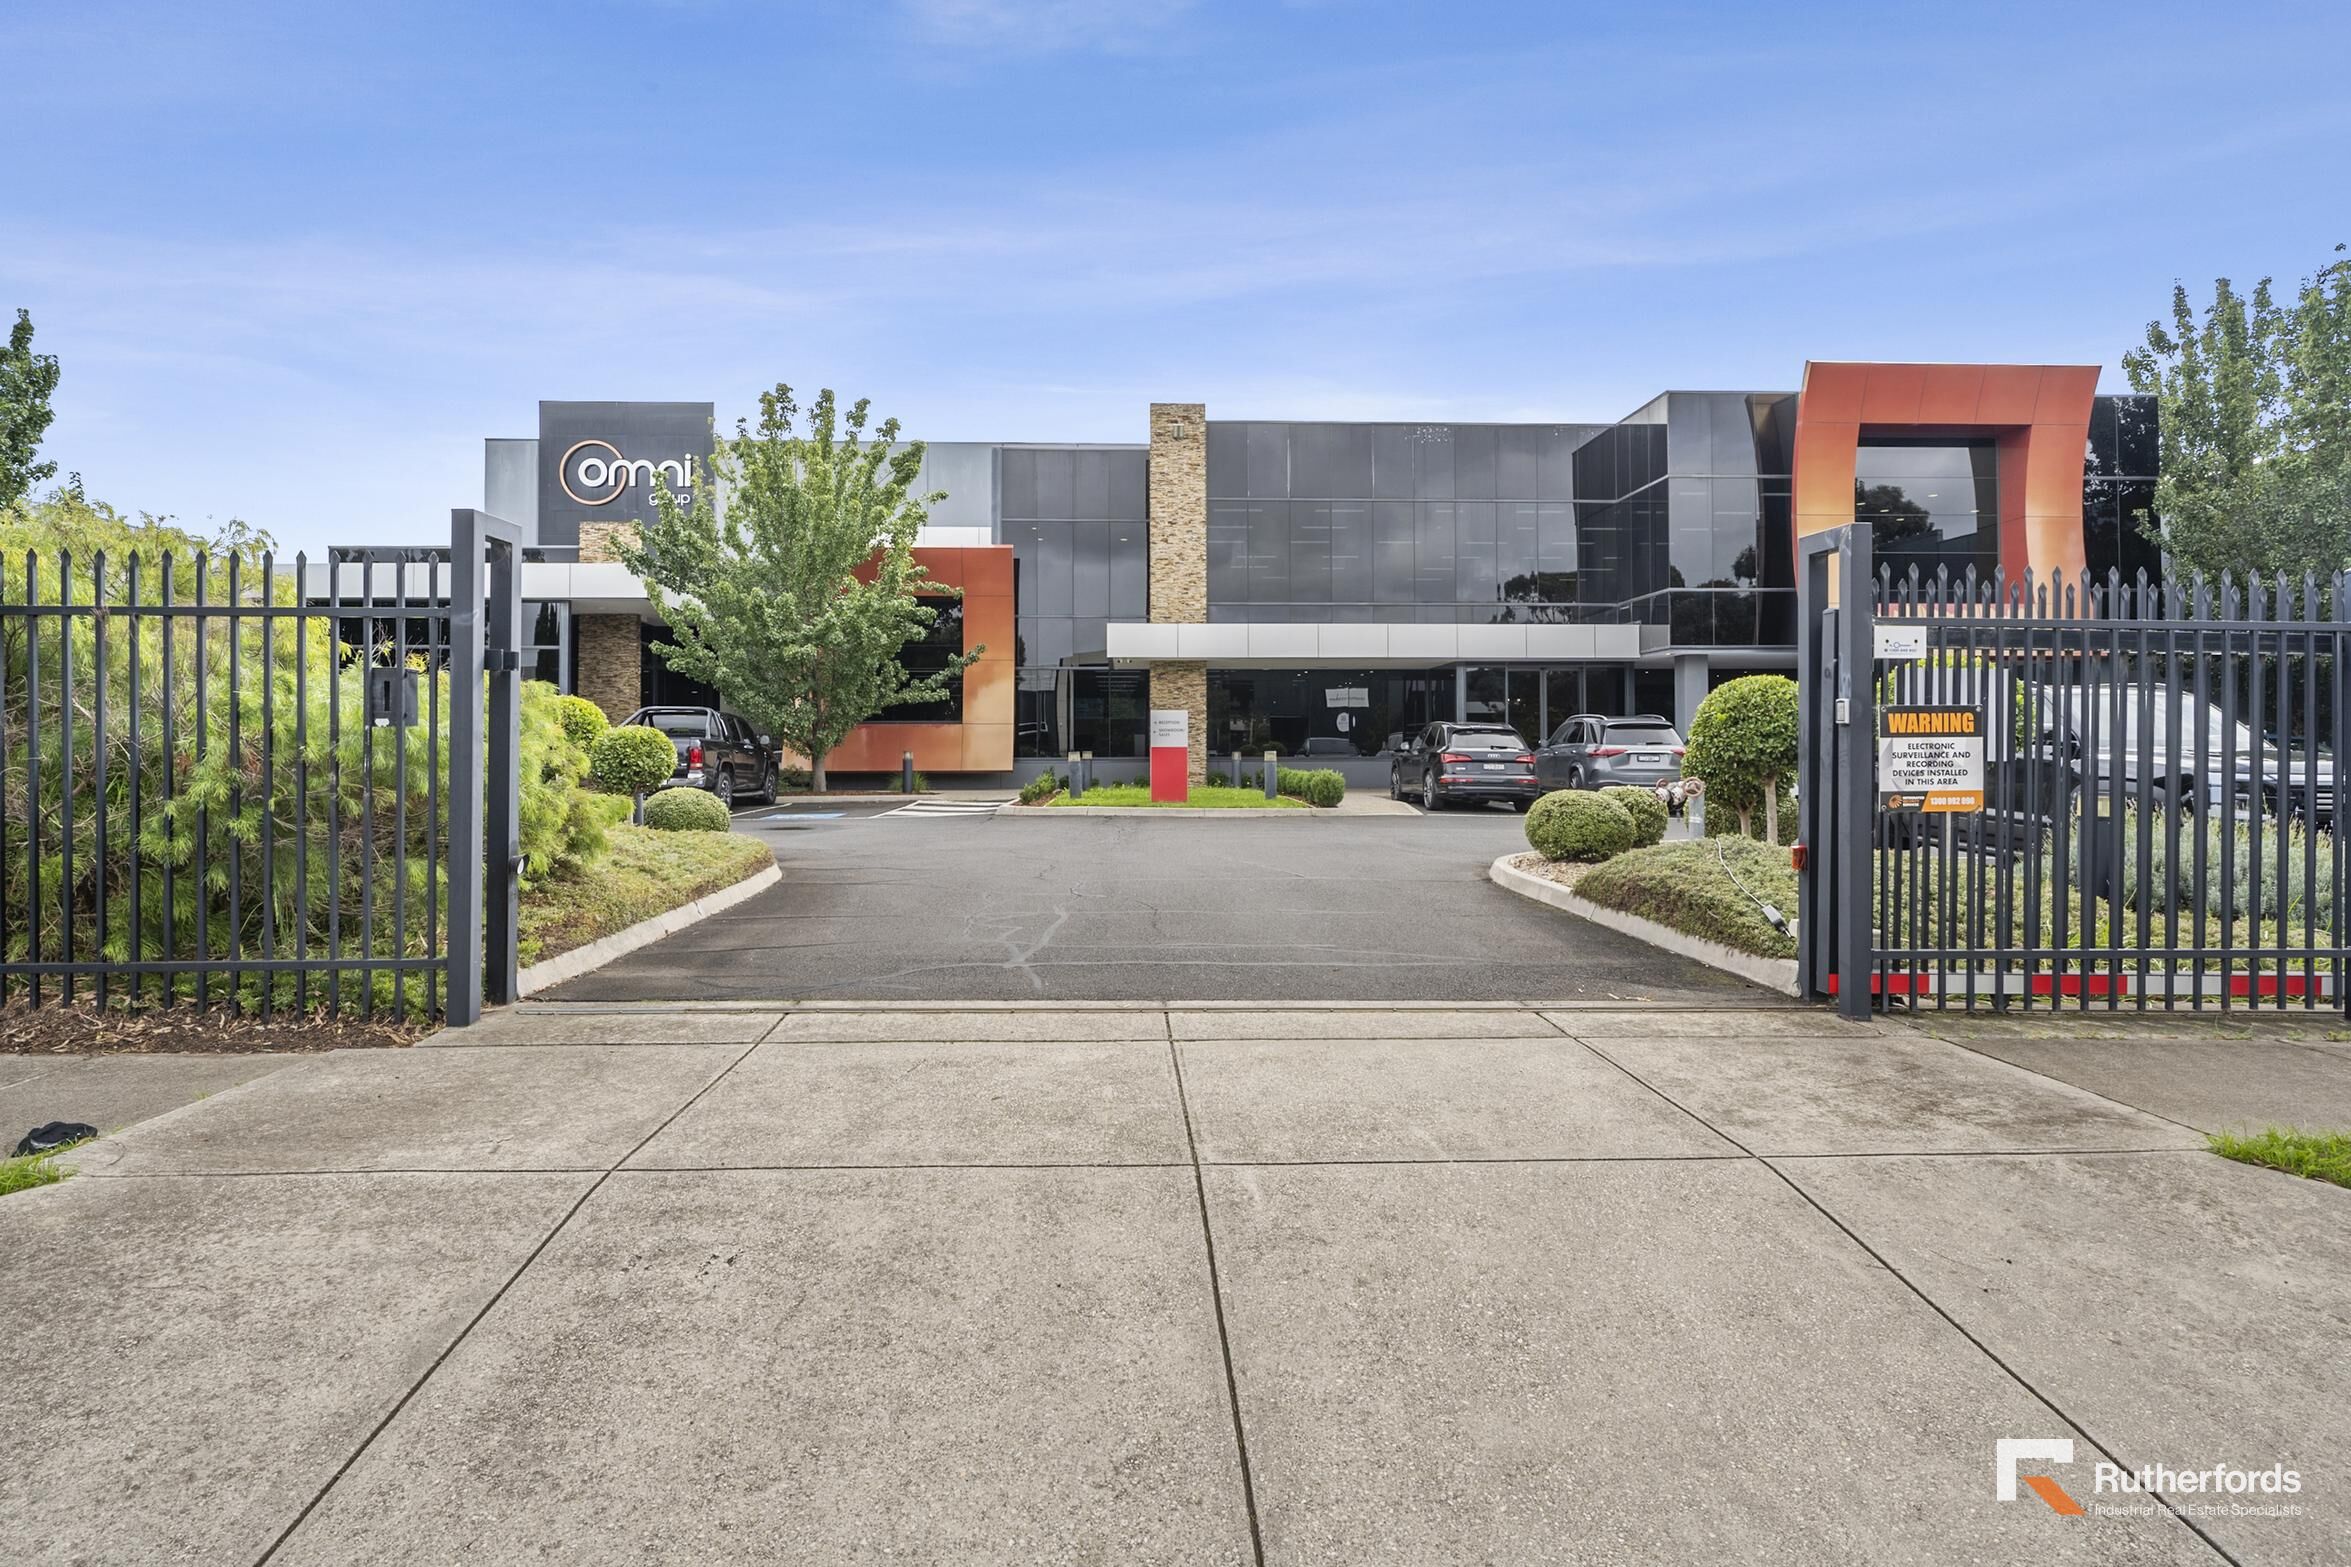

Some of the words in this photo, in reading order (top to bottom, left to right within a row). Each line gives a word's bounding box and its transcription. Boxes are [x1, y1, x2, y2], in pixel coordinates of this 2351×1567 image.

[578, 453, 693, 487] omni
[649, 493, 691, 506] gup
[1888, 712, 1975, 734] WARNING
